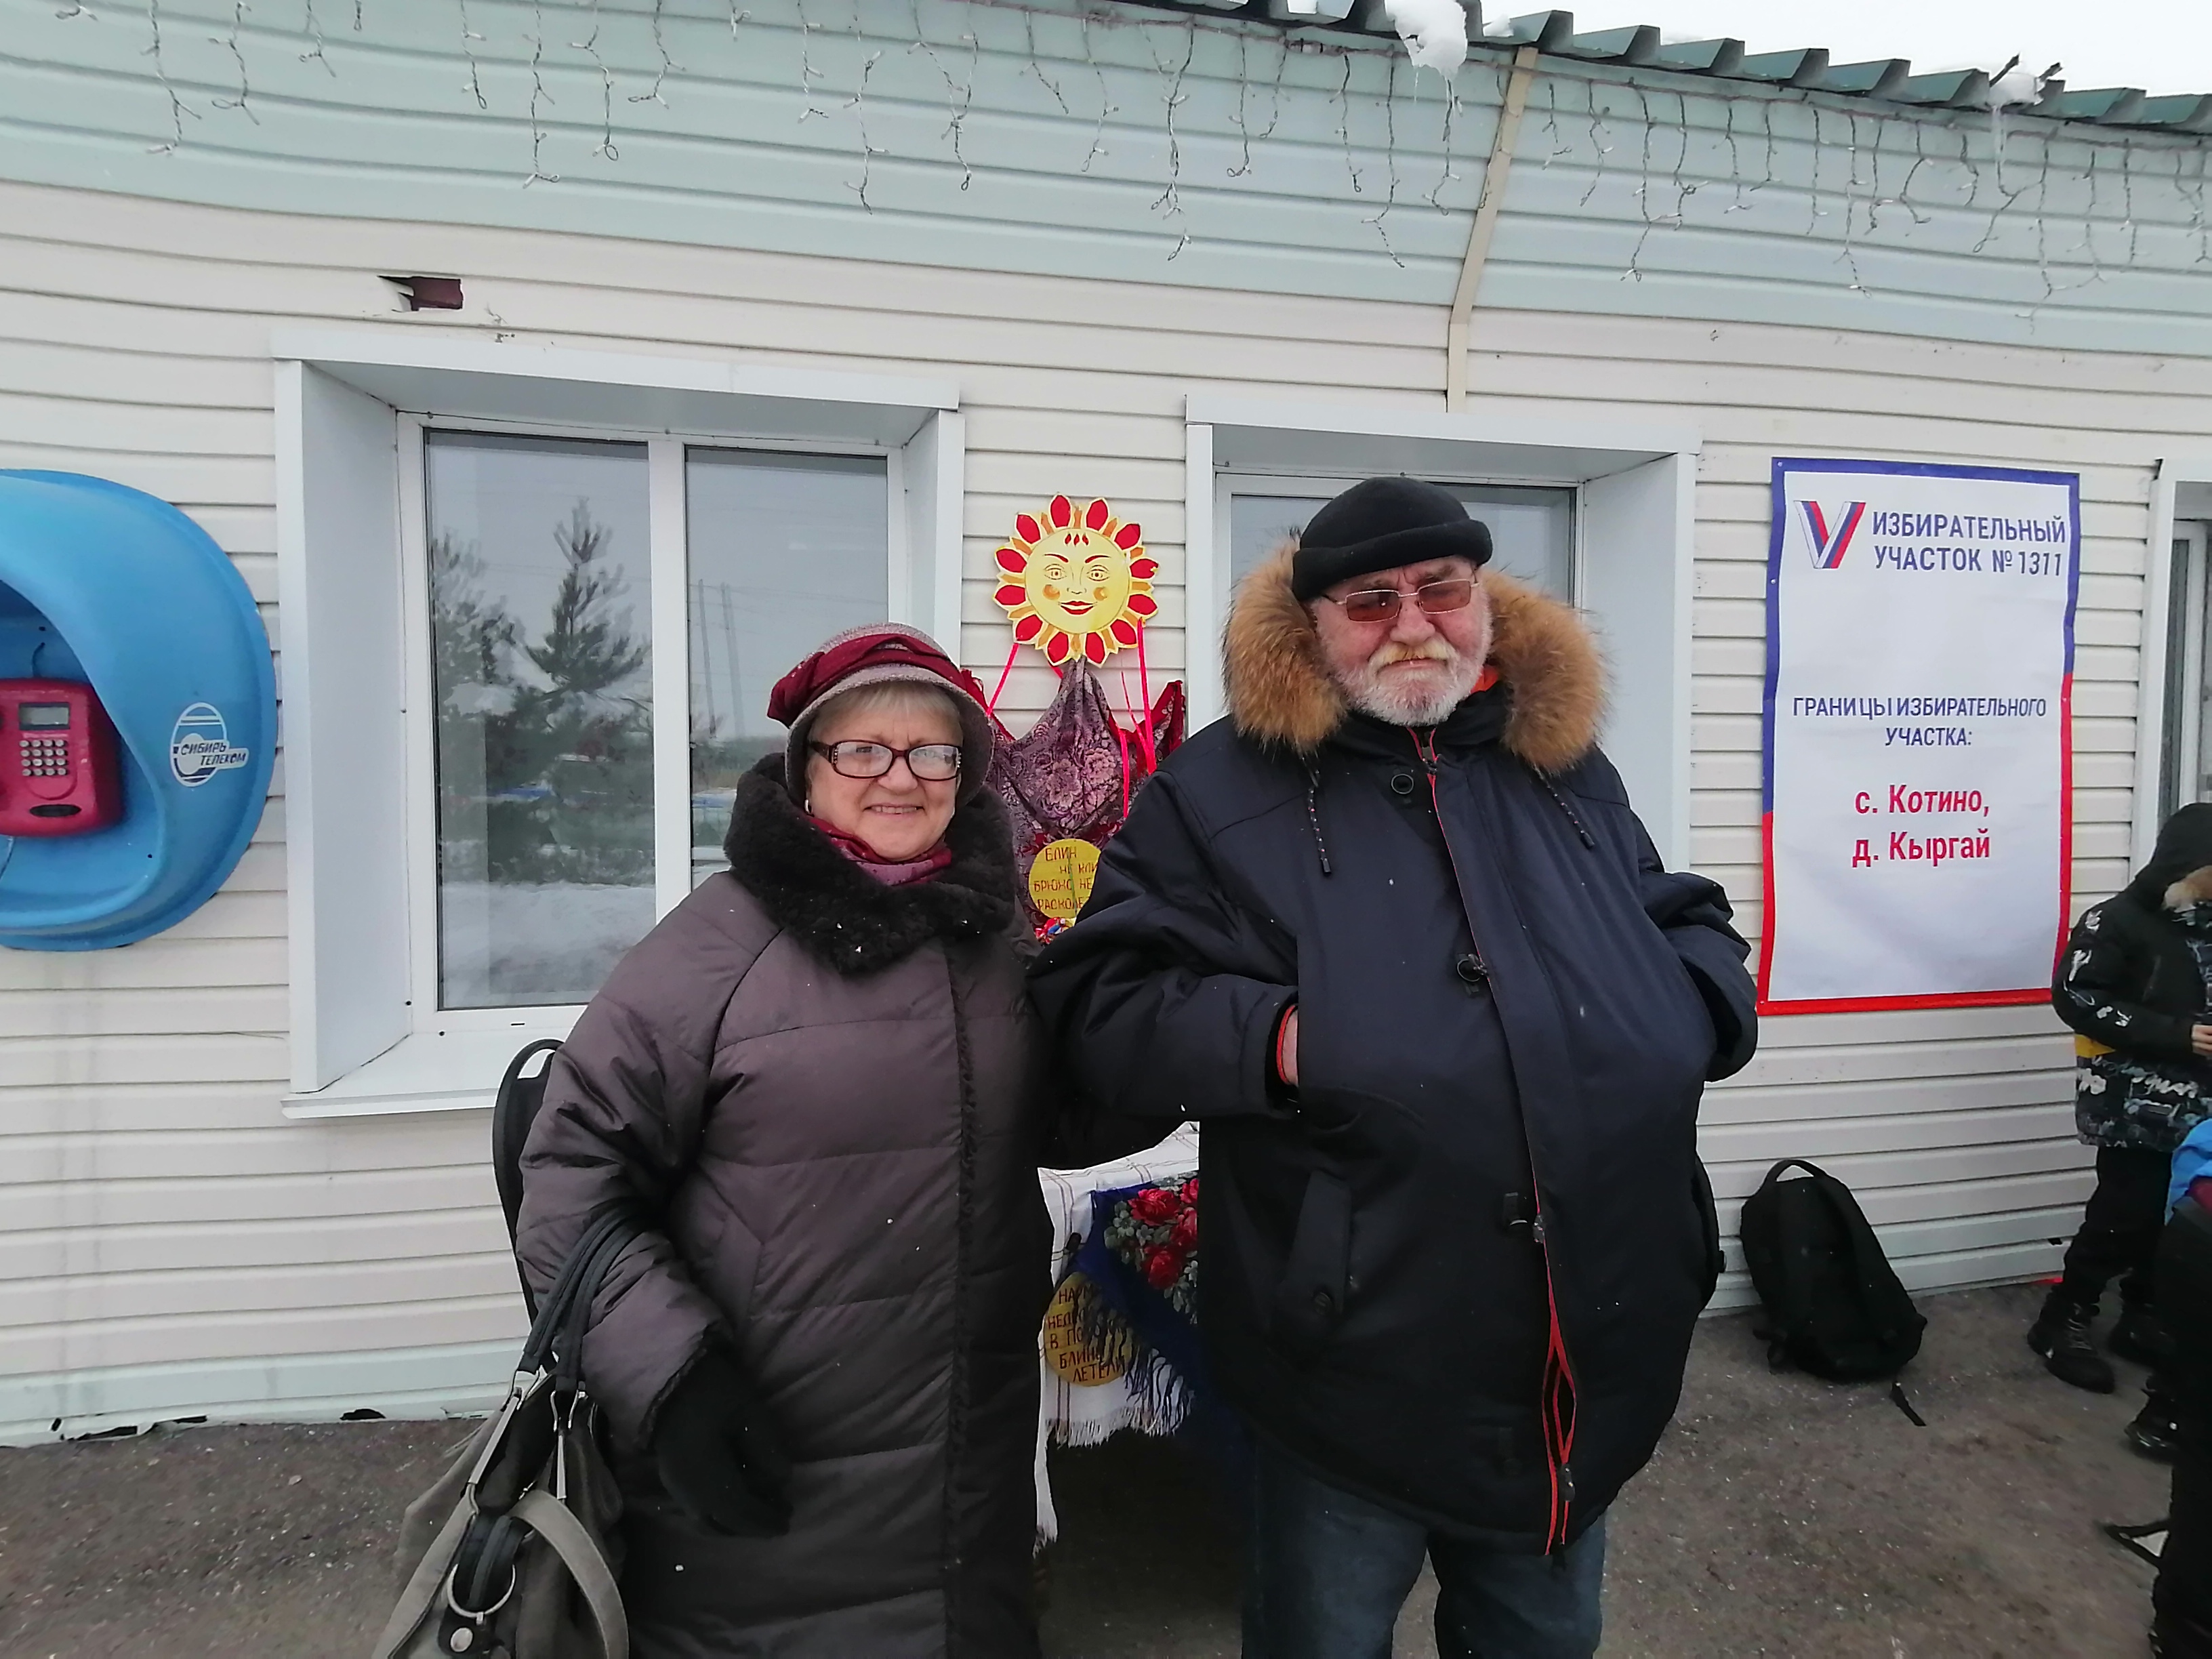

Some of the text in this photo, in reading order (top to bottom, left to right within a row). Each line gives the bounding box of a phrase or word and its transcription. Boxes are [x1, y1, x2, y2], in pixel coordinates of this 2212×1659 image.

[1872, 511, 2066, 543] ИЗБИРАТЕЛЬНЫЙ
[1874, 546, 1982, 571] УЧАСТОК
[2018, 551, 2062, 576] 1311
[1793, 697, 2047, 720] ГРАНИЦЫ ИЗБИРАТЕЛЬНОГО
[1885, 727, 1973, 746] УЧАСТКА:
[180, 742, 227, 756] СИБИРЬ
[200, 753, 246, 766] ТЕЛЕКОМ
[1854, 784, 1990, 817] с. Котино,
[1851, 828, 1990, 868] д. Кыргай
[1080, 878, 1092, 890] НЕ
[1038, 896, 1090, 909] РАСКОЛЕ
[1050, 1333, 1059, 1349] В
